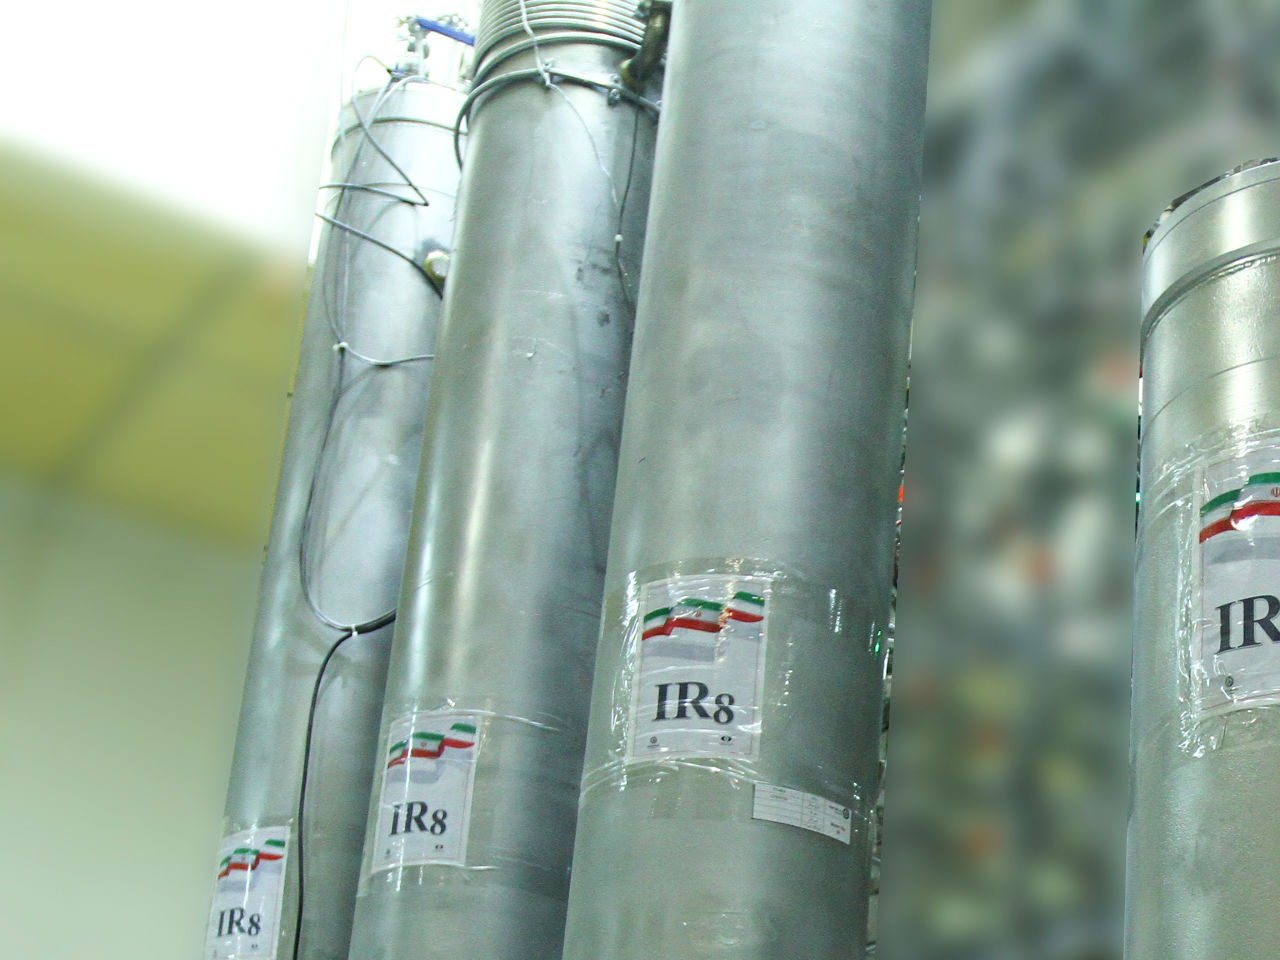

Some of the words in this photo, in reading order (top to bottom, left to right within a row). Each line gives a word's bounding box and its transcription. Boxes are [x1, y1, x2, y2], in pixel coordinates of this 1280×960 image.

[651, 681, 735, 725] IR8
[388, 801, 448, 837] IR8
[217, 907, 261, 938] IR8
